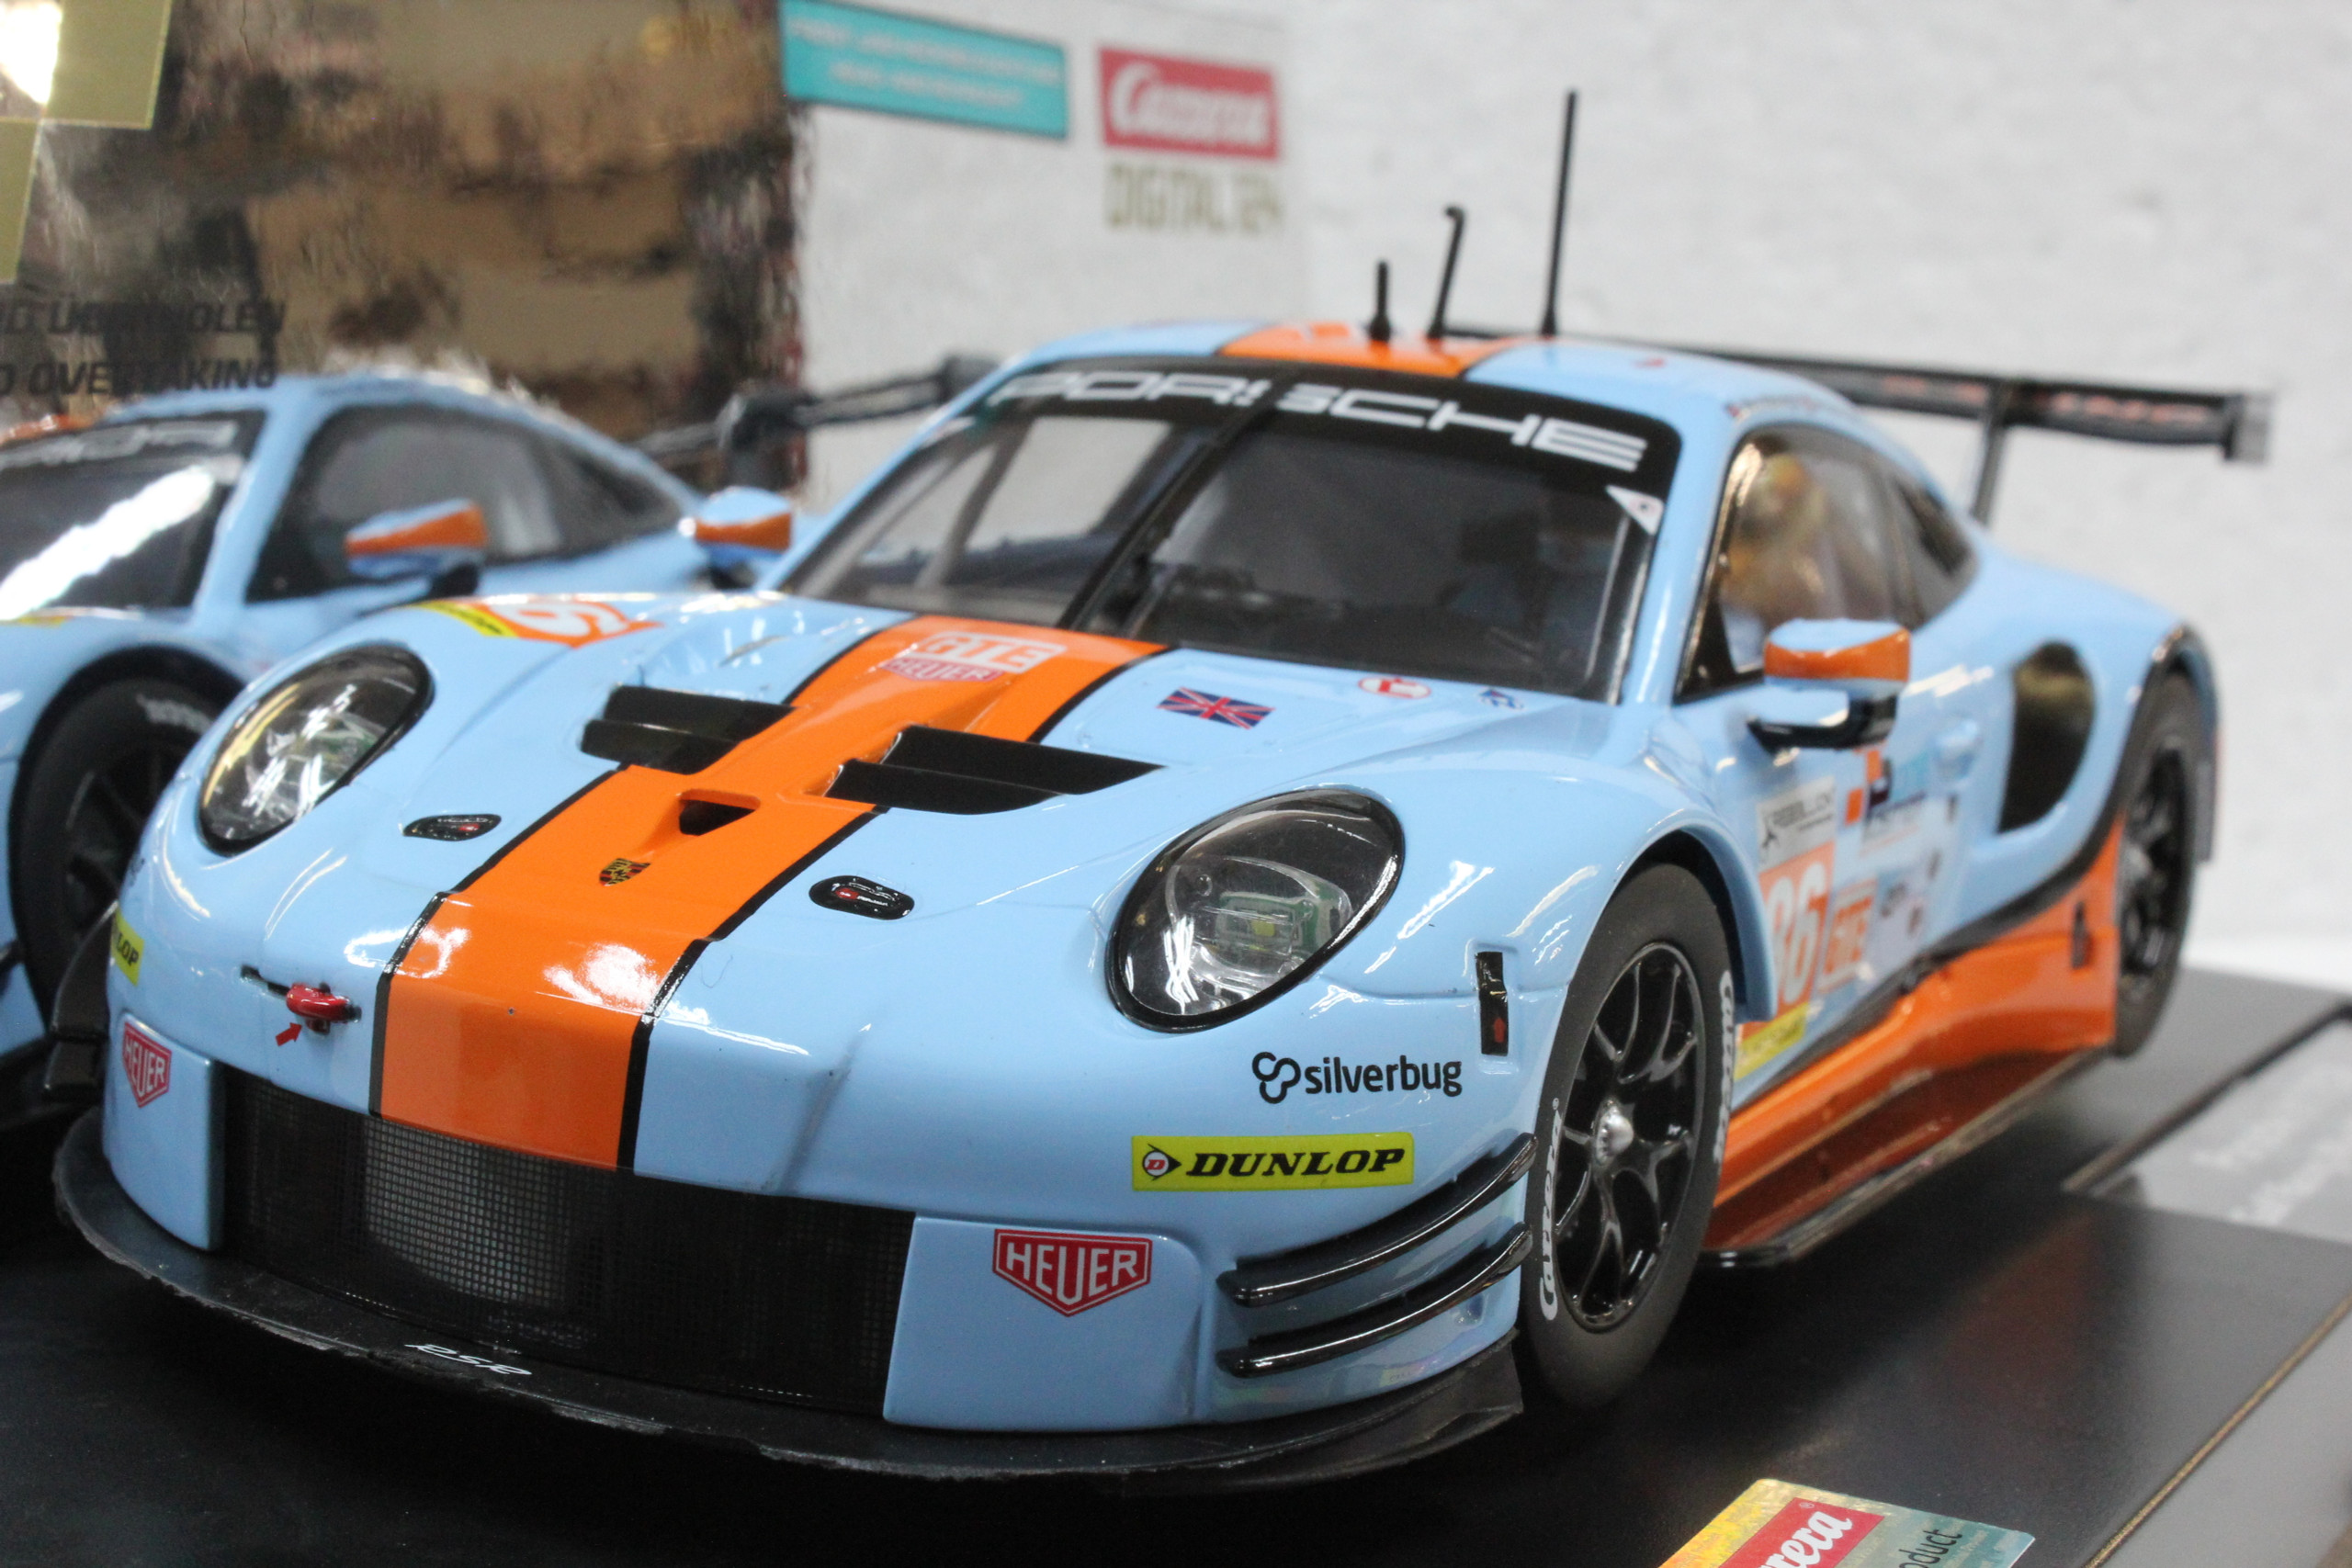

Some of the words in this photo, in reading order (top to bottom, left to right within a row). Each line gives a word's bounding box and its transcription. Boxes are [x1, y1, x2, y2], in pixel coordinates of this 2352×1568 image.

[986, 370, 1648, 472] PORSCHE
[923, 635, 1056, 669] GTE
[124, 1035, 166, 1098] HEUER
[1304, 1054, 1464, 1097] silverbug
[1185, 1148, 1406, 1177] DUNLOP
[1006, 1242, 1138, 1305] HEUER
